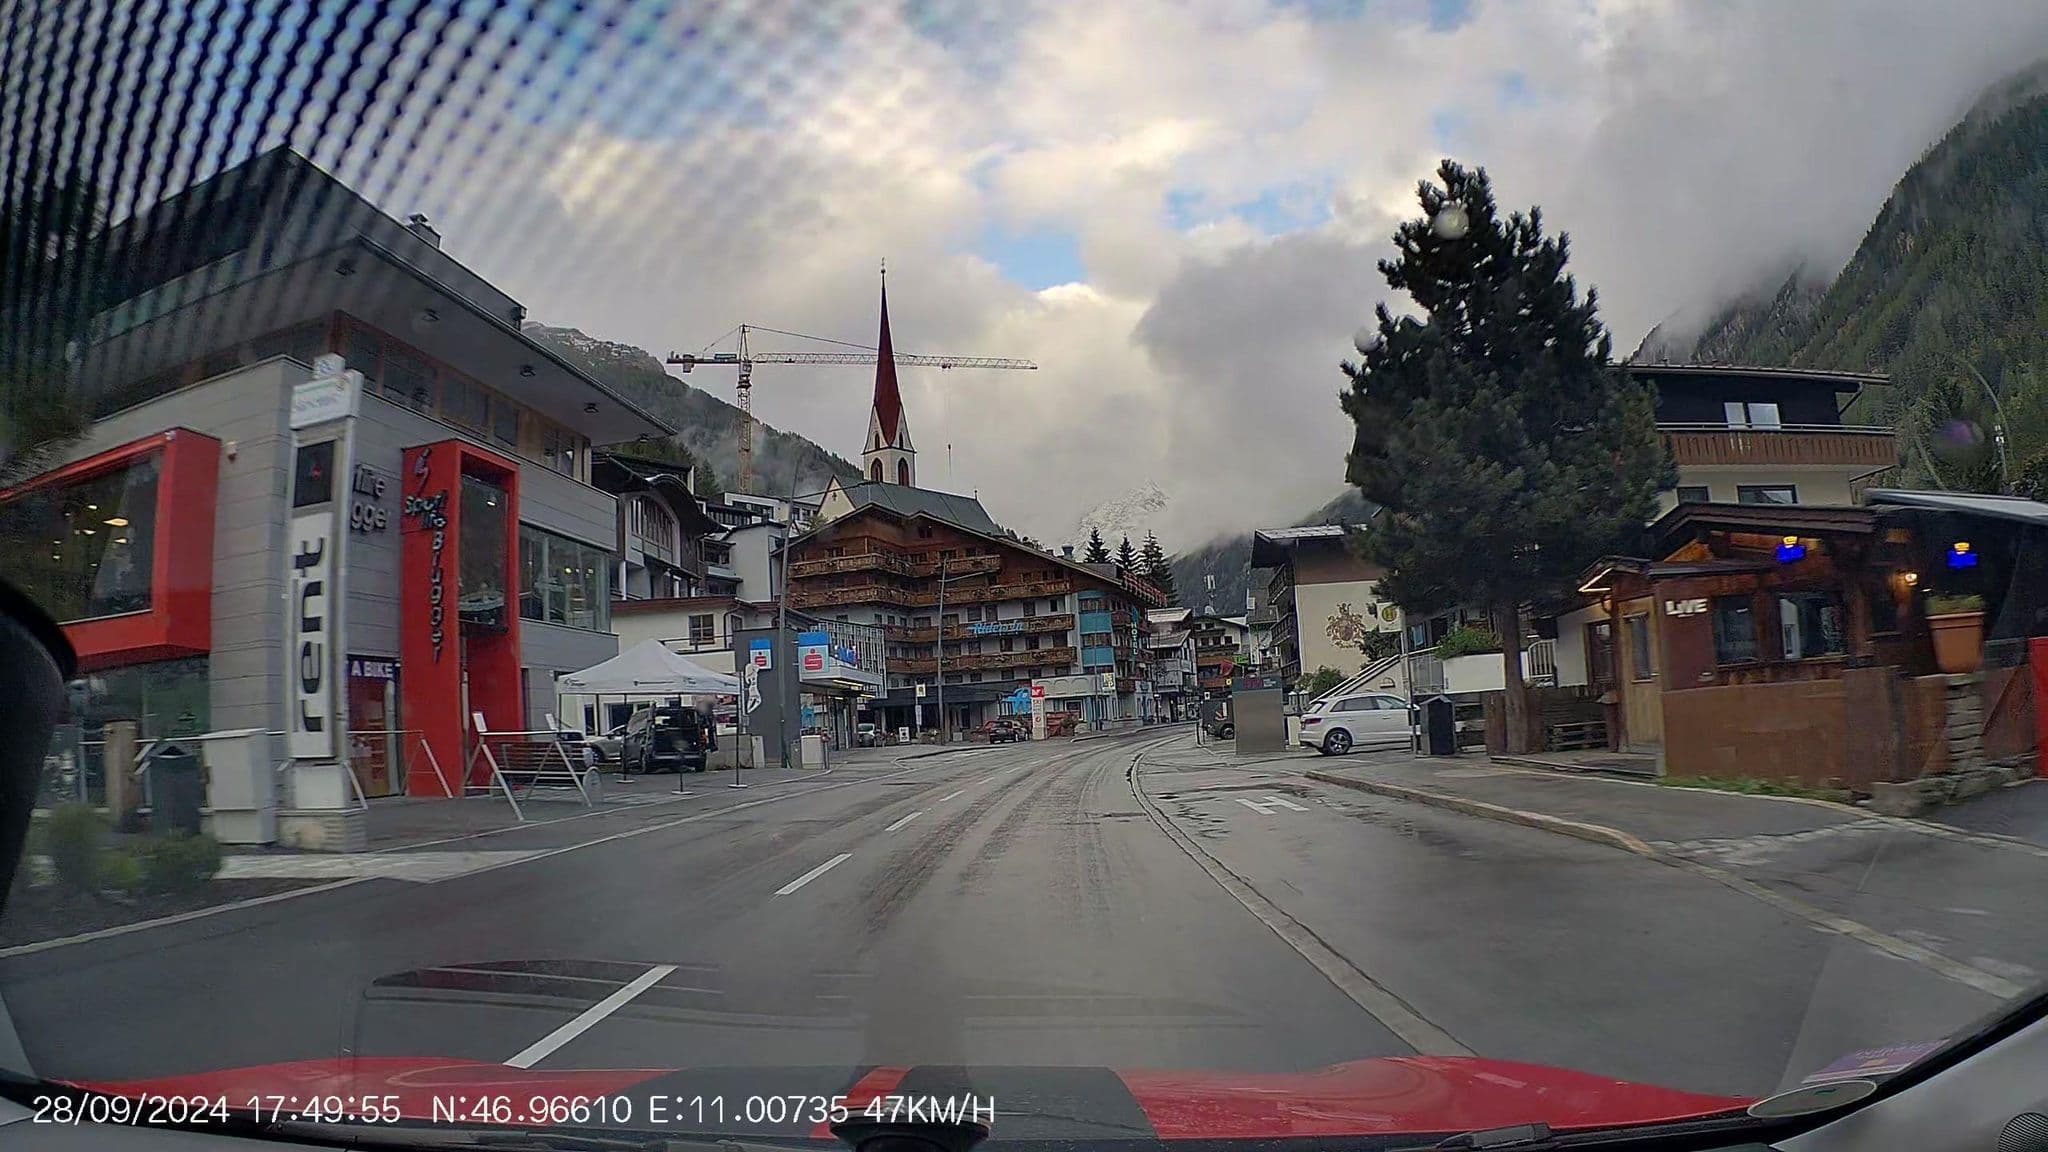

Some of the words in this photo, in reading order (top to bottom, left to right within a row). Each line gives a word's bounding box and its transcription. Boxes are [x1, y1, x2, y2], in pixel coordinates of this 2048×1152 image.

[293, 538, 324, 733] rent
[351, 660, 362, 676] A
[363, 660, 393, 678] BIKE
